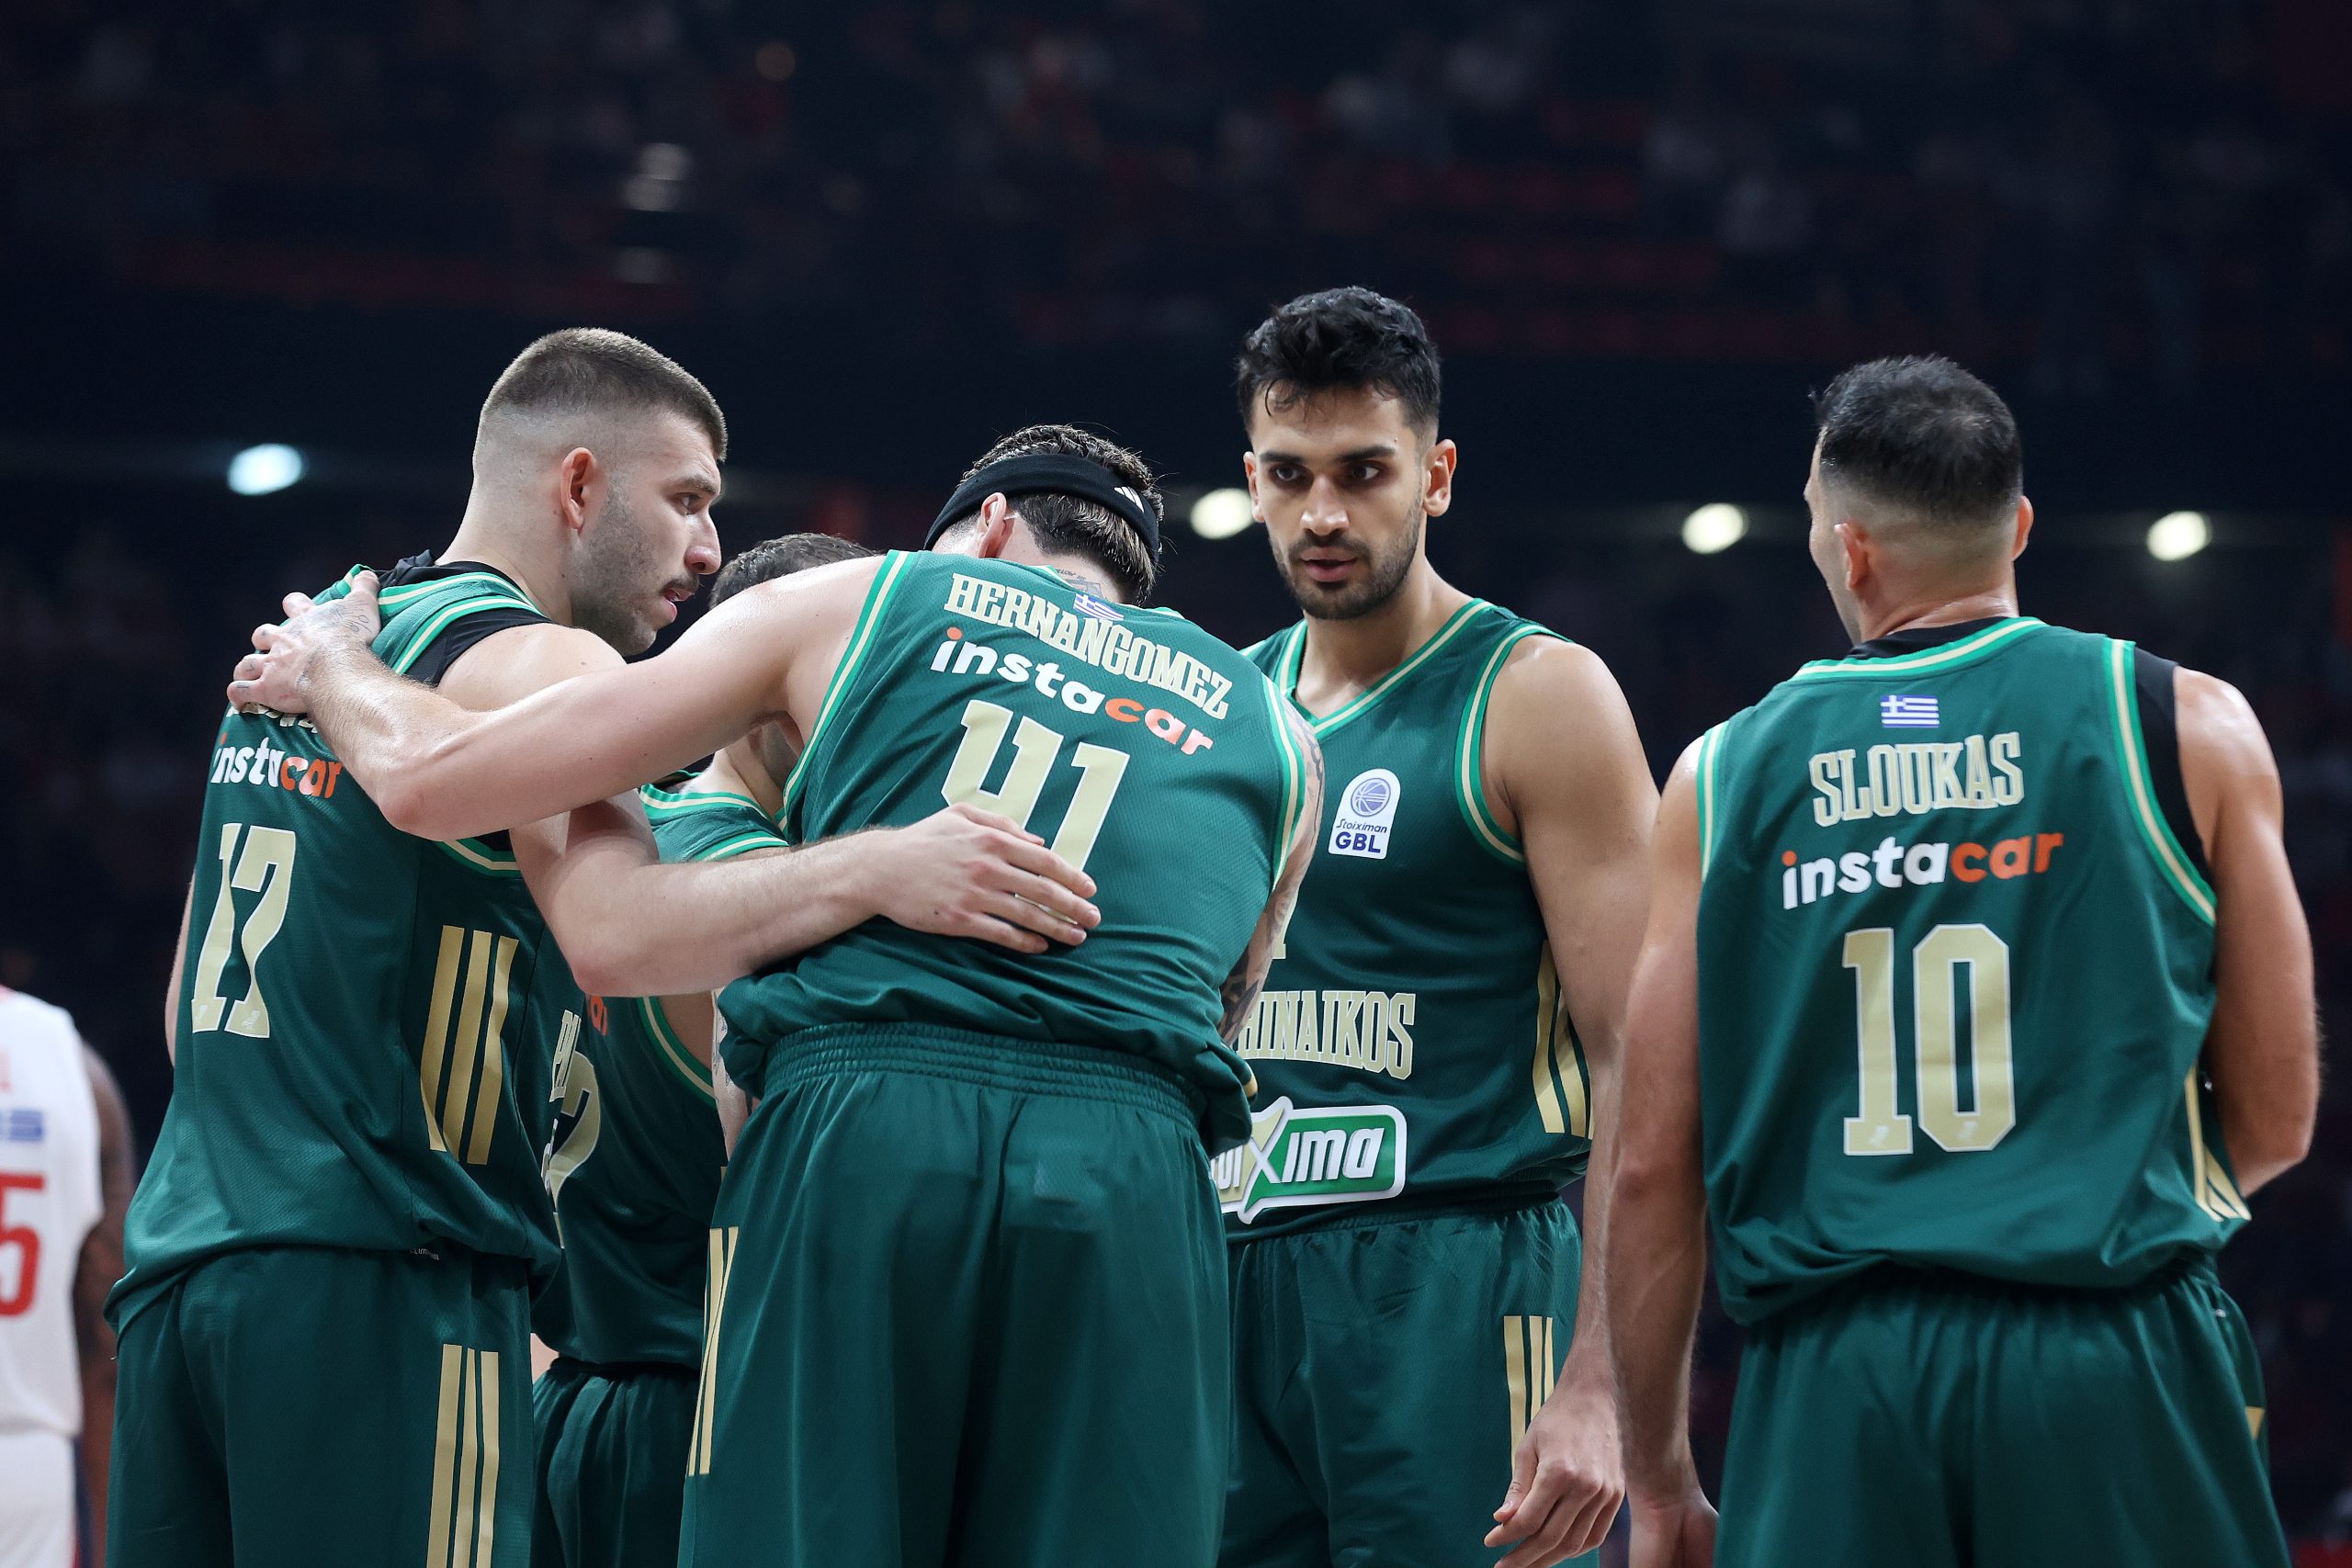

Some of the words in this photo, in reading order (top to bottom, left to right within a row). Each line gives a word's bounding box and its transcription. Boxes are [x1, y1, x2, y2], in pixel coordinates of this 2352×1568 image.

[930, 626, 1214, 755] instacar
[944, 572, 1233, 720] HERNANGOMEZ
[210, 732, 343, 799] instacar
[940, 699, 1131, 872] 41
[1808, 731, 2024, 827] SLOUKAS
[1335, 831, 1381, 853] GBL
[1336, 818, 1388, 834] Stoiximan
[1781, 832, 2064, 909] instacar
[191, 823, 297, 1038] 17
[1236, 990, 1417, 1080] HINAIKOS
[1842, 923, 2017, 1156] 10
